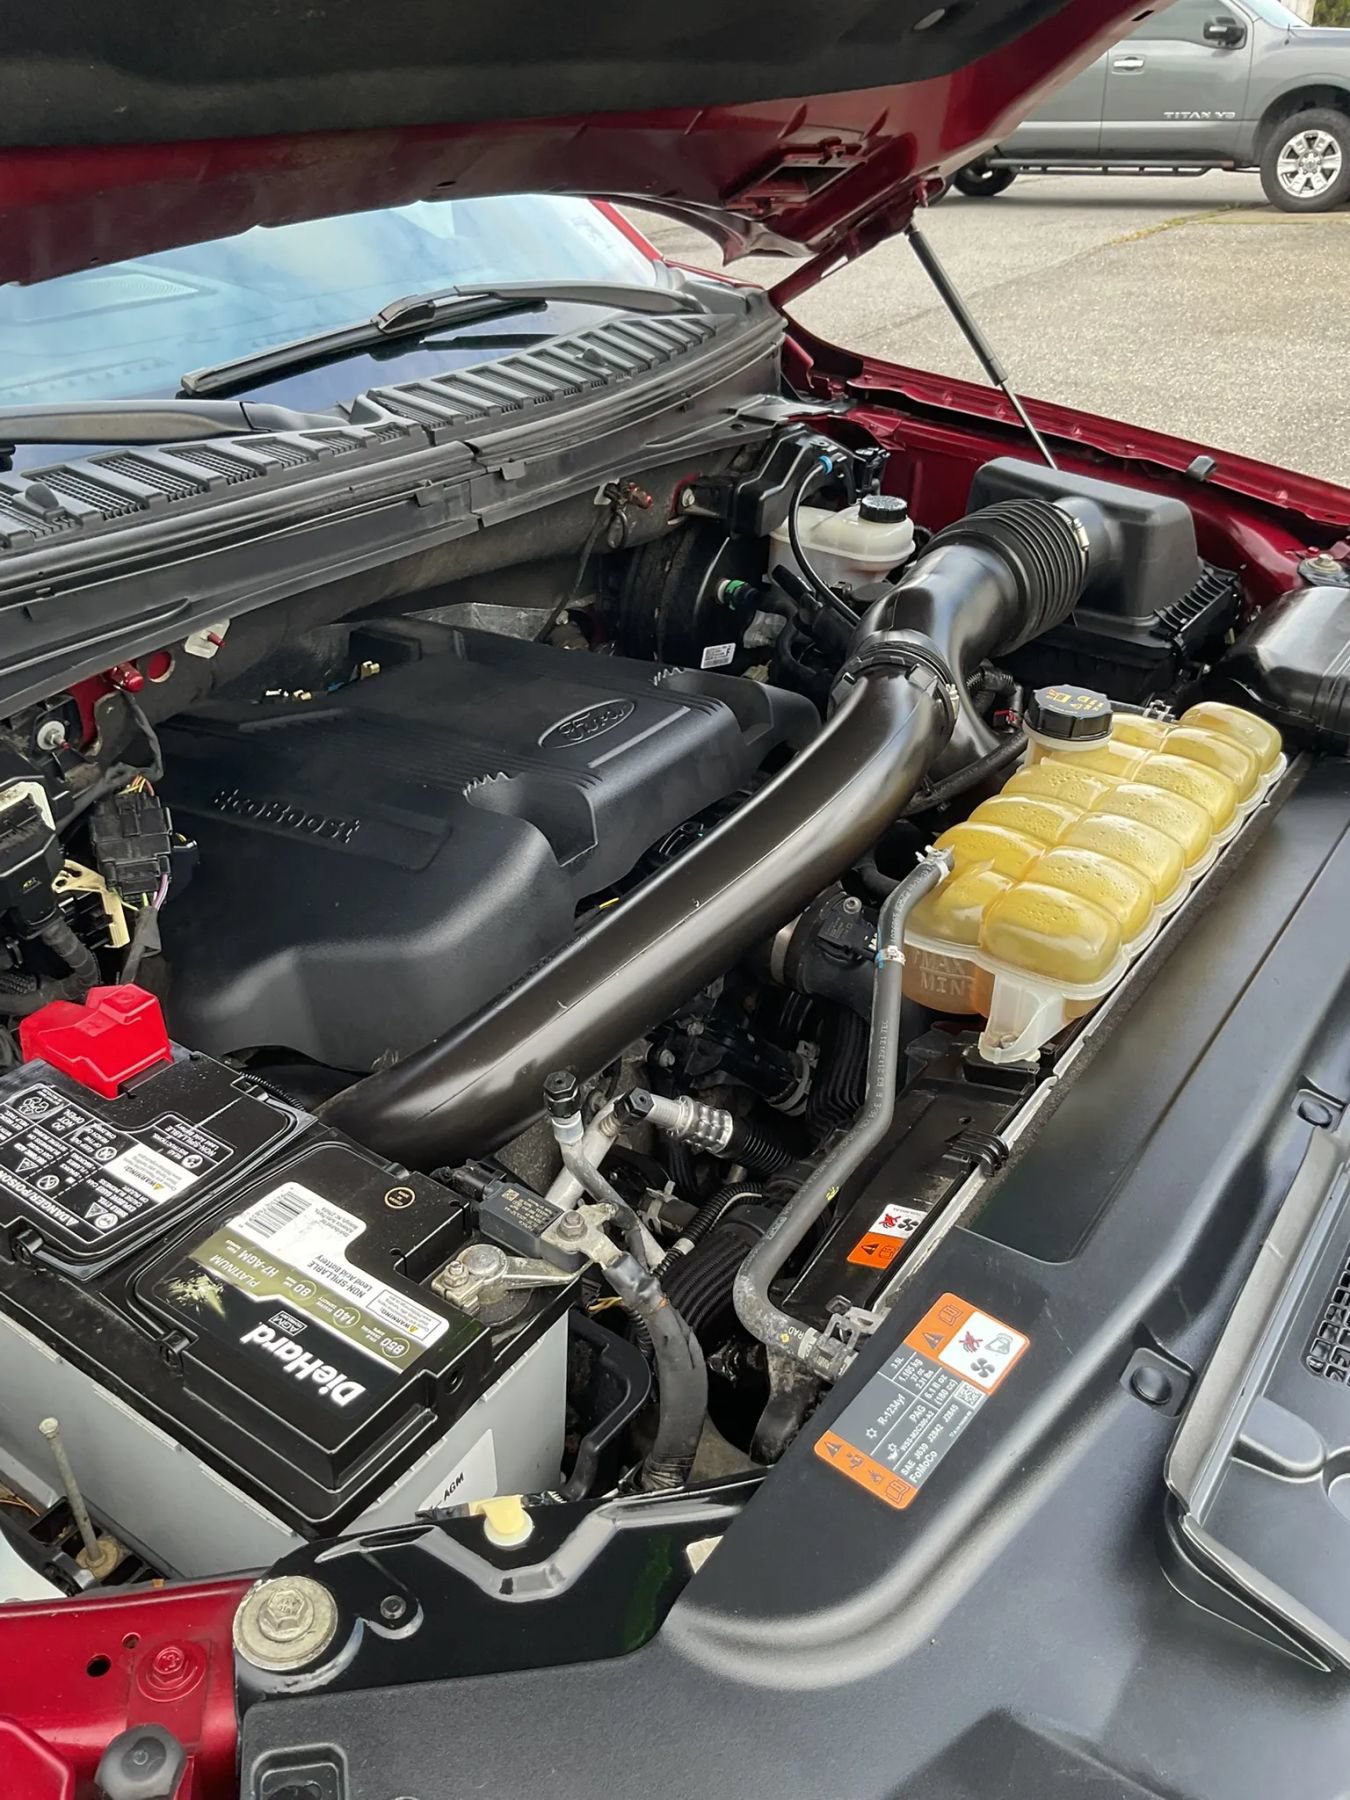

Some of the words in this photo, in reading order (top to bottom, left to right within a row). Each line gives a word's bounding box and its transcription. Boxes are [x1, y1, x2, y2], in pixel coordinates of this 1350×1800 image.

[1164, 111, 1211, 119] TITAN
[920, 972, 966, 996] MIN
[49, 1121, 67, 1131] DO
[56, 1116, 76, 1127] NOT
[164, 1123, 217, 1158] NON-SPILLABLE
[208, 1253, 261, 1287] PLATINUM
[237, 1249, 279, 1277] H7-AGM
[313, 1253, 343, 1273] Battery
[306, 1259, 366, 1298] NON-SPILLABLE
[338, 1269, 356, 1281] Acid
[292, 1283, 312, 1297] 80
[353, 1278, 373, 1292] Lead
[271, 1314, 300, 1334] AGM
[332, 1307, 356, 1324] 140
[377, 1306, 411, 1328] WARNING:
[378, 1336, 406, 1355] 850
[236, 1321, 368, 1408] DieHard
[936, 1373, 948, 1384] oz
[944, 1378, 958, 1391] cc)
[876, 1392, 908, 1426] R-1234yf
[908, 1404, 926, 1422] PAG
[900, 1459, 915, 1476] SAE
[908, 1449, 937, 1483] FoMoCo
[443, 1471, 464, 1499] AGM
